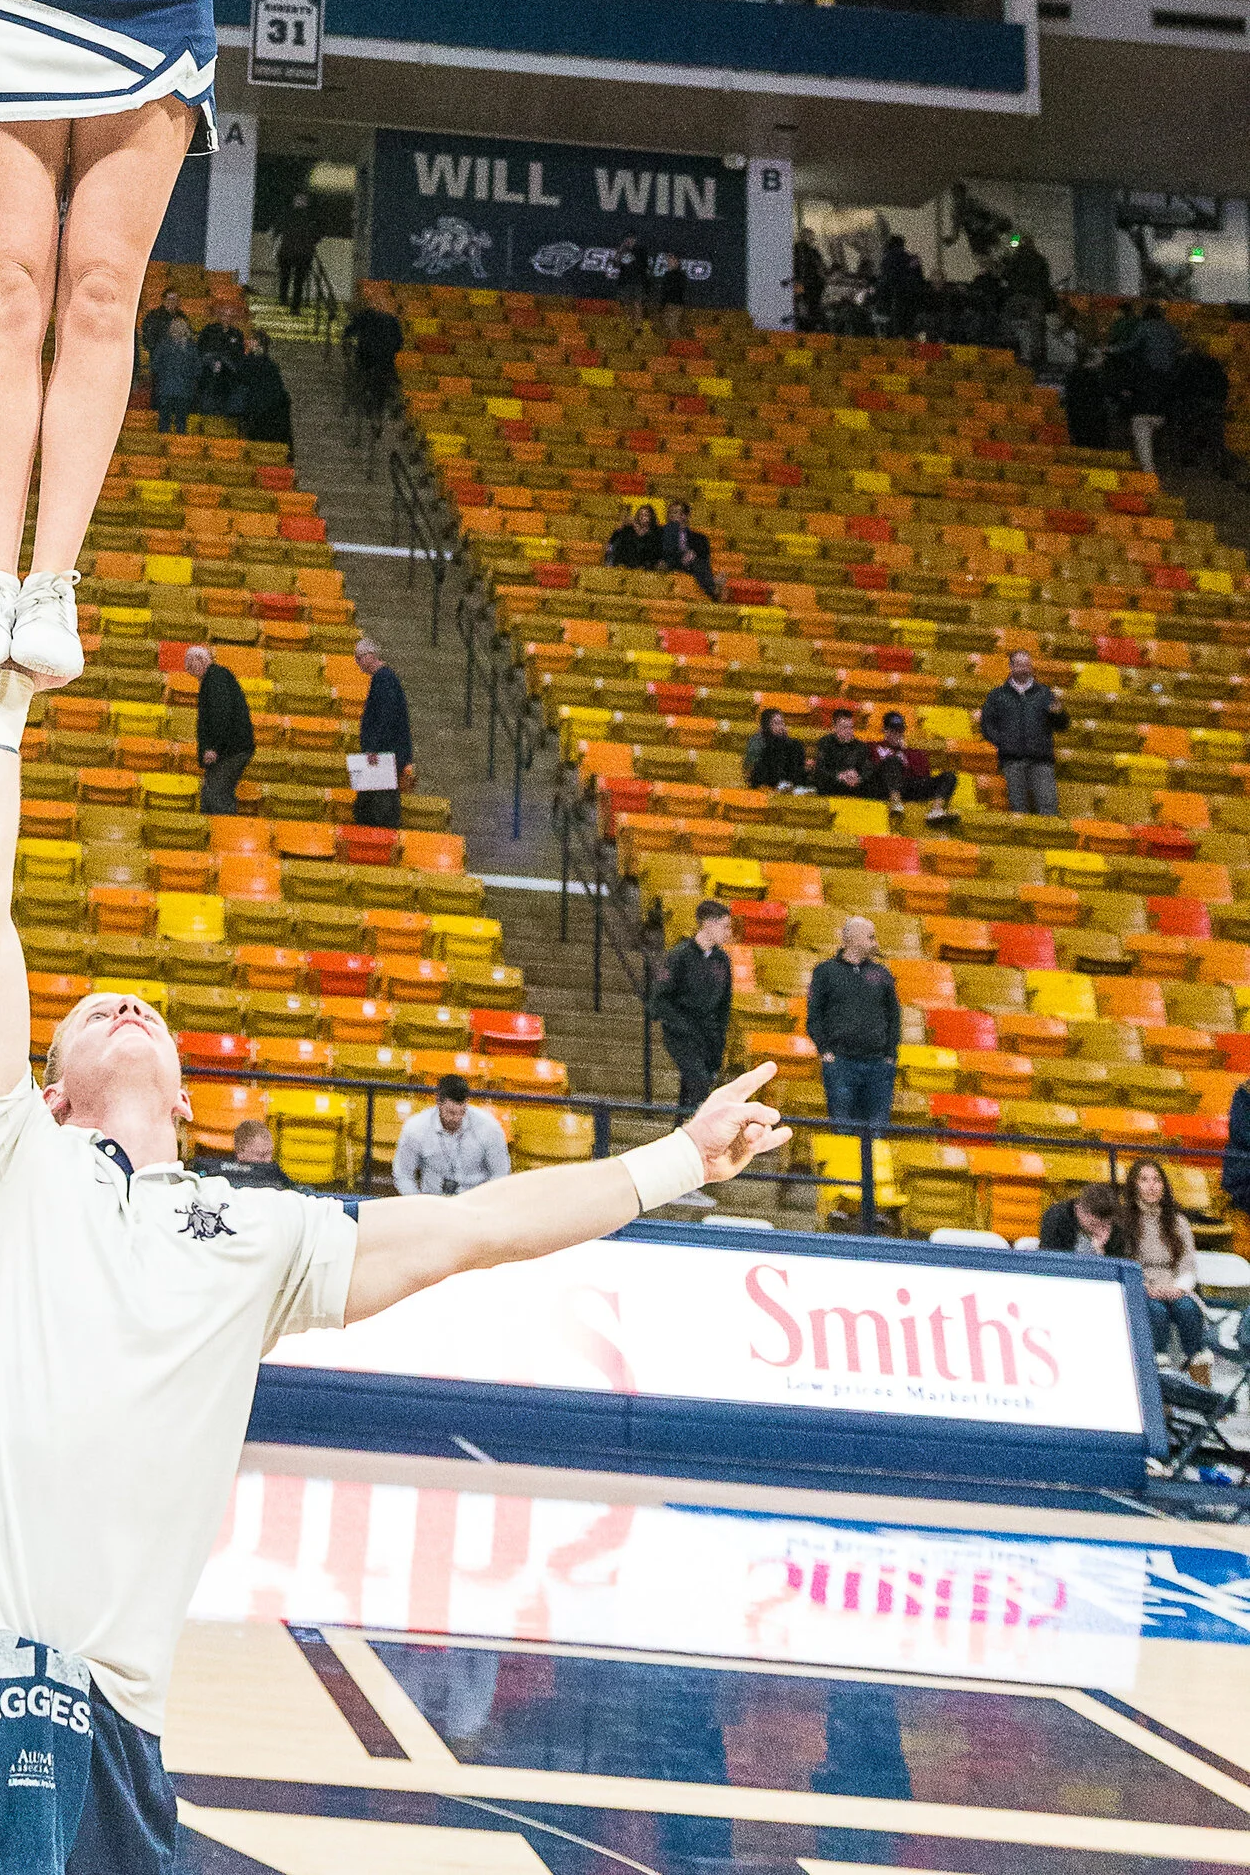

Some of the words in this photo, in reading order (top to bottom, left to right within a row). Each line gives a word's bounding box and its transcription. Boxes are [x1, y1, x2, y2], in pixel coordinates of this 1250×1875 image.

[266, 18, 307, 46] 31
[224, 121, 246, 146] A
[414, 150, 562, 208] WILL
[595, 166, 718, 220] WIN
[762, 166, 782, 191] B
[745, 1263, 1060, 1389] Smith's
